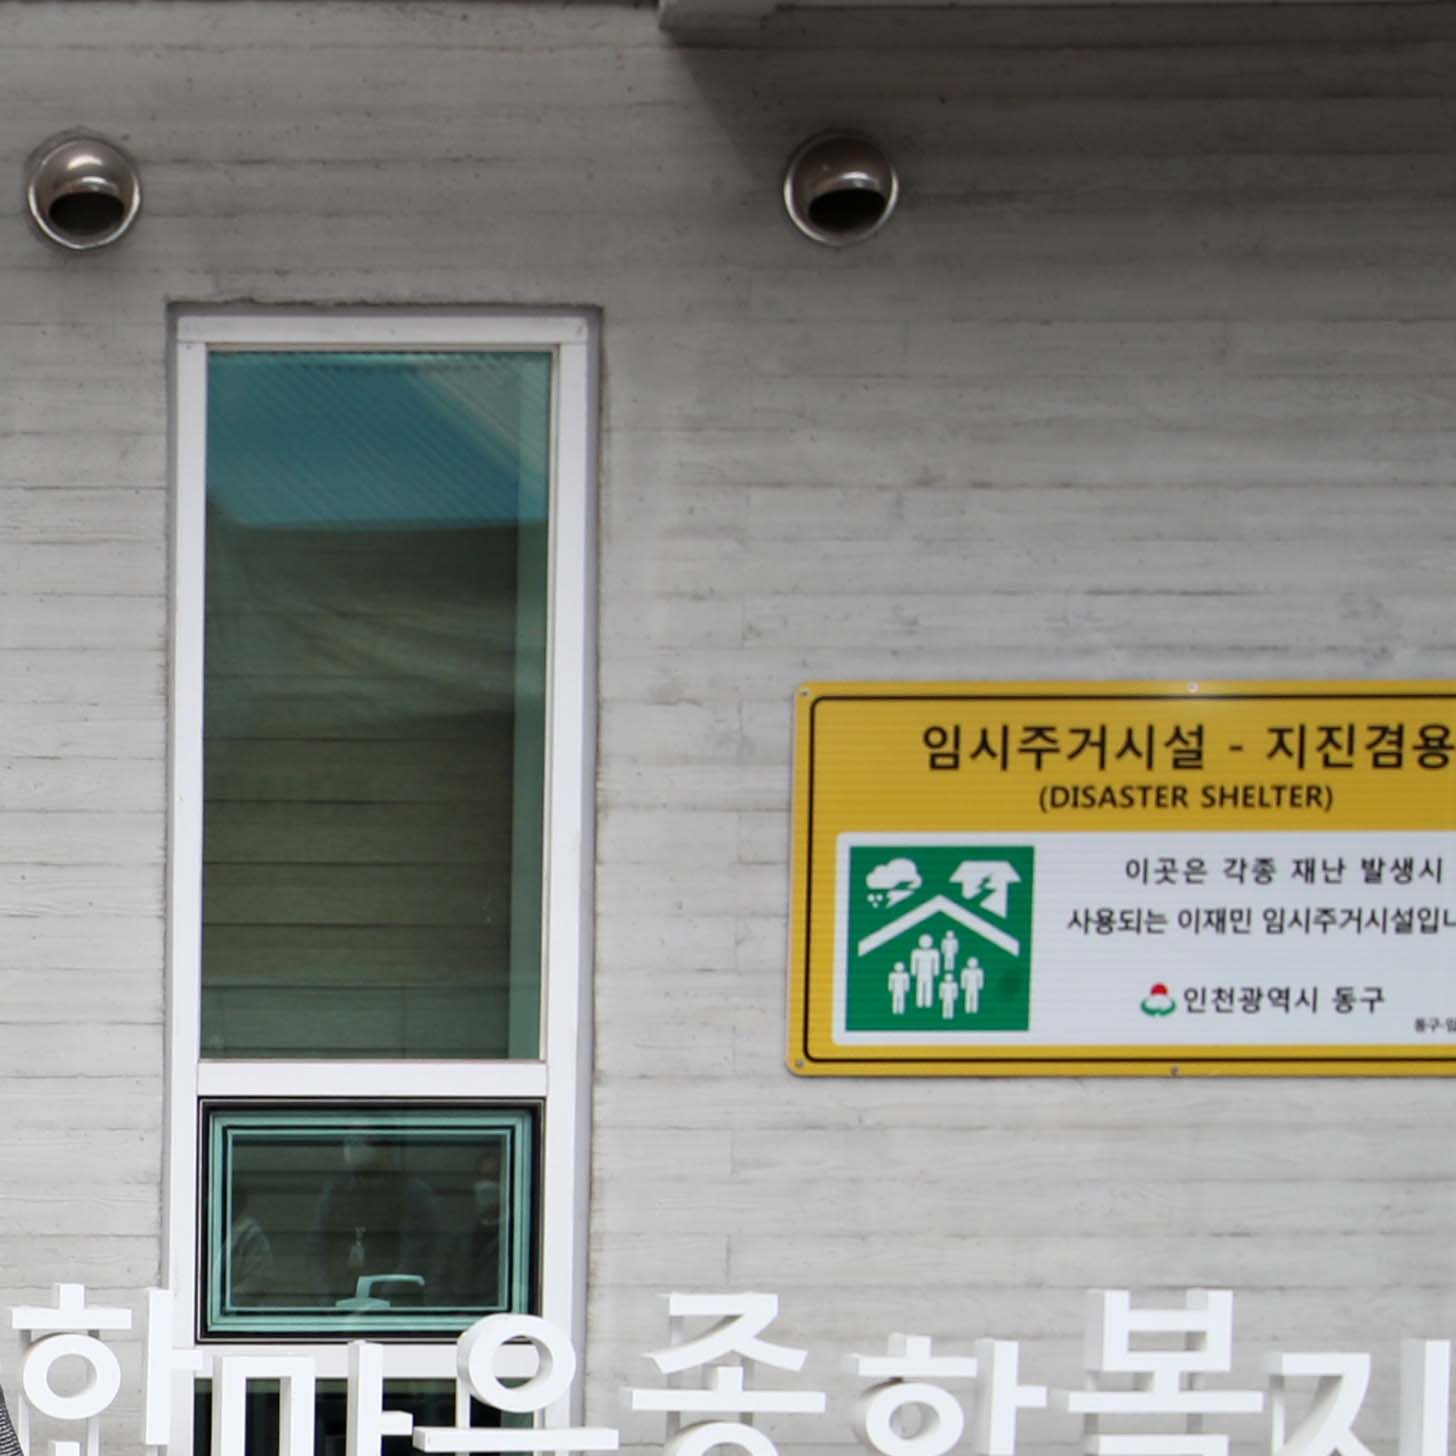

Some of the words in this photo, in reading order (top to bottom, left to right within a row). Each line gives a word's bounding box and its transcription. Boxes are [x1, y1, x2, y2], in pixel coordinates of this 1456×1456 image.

[922, 723, 1205, 772] 임시주거시설
[1266, 722, 1456, 771] 지진겸용
[1038, 784, 1189, 813] (DISASTER
[1201, 784, 1334, 813] SHELTER)
[1125, 857, 1208, 885] 이곳은
[1223, 857, 1276, 886] 각종
[1291, 857, 1347, 885] 재난
[1360, 857, 1444, 885] 발생시
[1067, 907, 1168, 936] 사용되는
[1177, 907, 1253, 935] 이재민
[1183, 986, 1318, 1014] 인천광역시
[1332, 986, 1385, 1014] 동구
